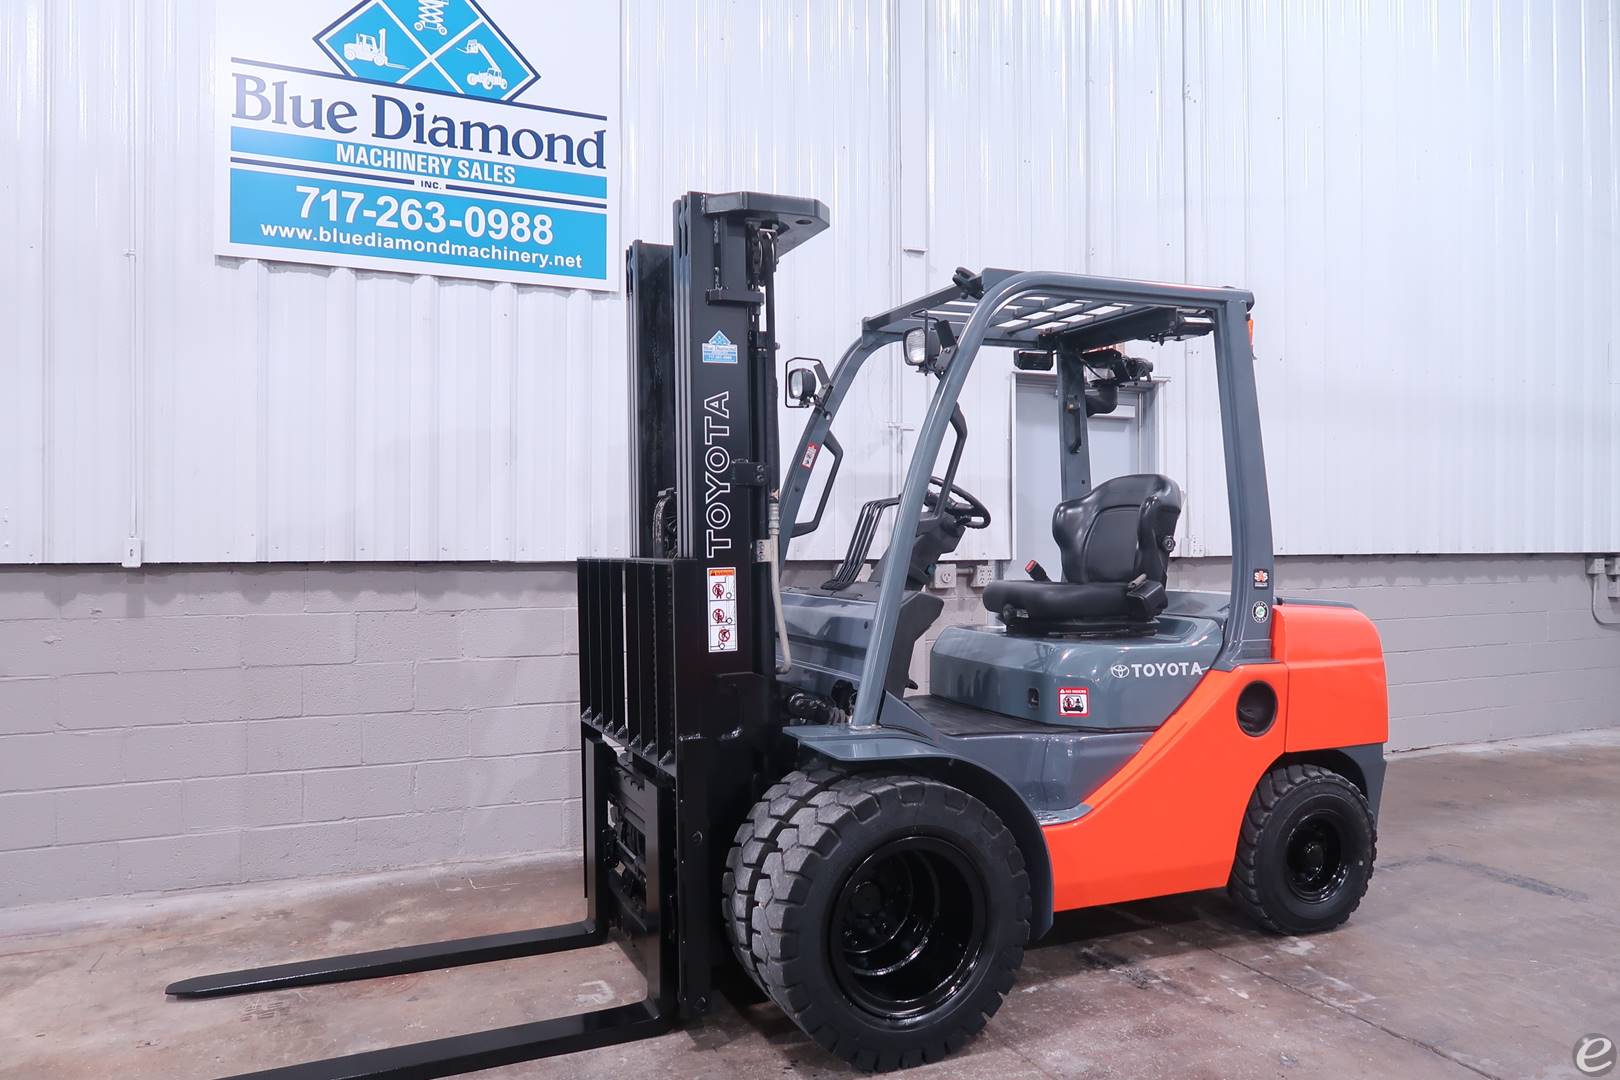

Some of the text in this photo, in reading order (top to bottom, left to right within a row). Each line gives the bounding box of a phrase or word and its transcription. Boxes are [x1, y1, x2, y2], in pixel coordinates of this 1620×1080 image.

[232, 73, 607, 170] Blue Diamond
[336, 143, 516, 184] MACHINERY SALES
[420, 180, 442, 190] INC.
[295, 185, 554, 245] 717-263-0988
[260, 223, 583, 269] www.bluediamondmachinery.net
[704, 391, 732, 559] TOYOTA
[1131, 661, 1203, 678] TOYOTA
